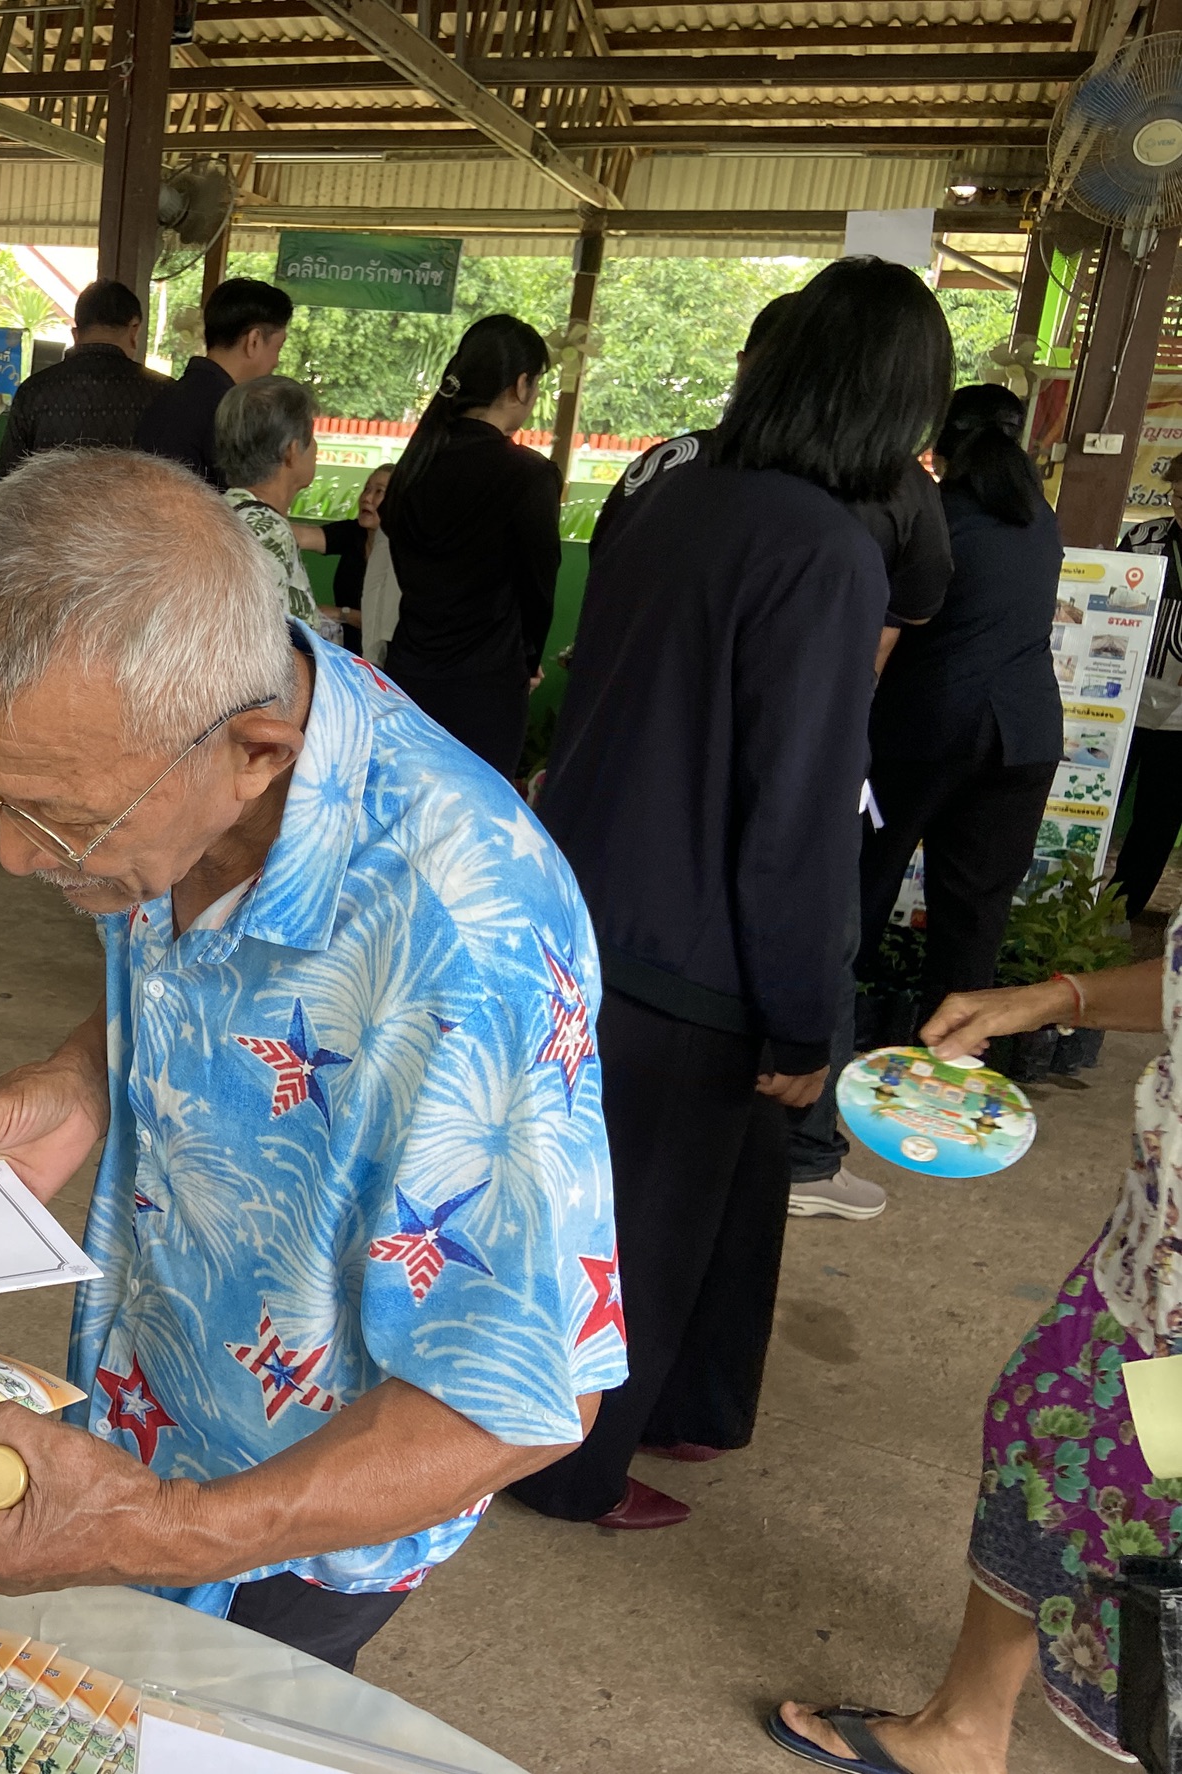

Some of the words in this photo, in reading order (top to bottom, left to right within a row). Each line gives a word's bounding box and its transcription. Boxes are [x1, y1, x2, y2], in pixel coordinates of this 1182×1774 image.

[286, 256, 445, 287] คลินิกอารักขาพืช
[1107, 616, 1142, 628] START
